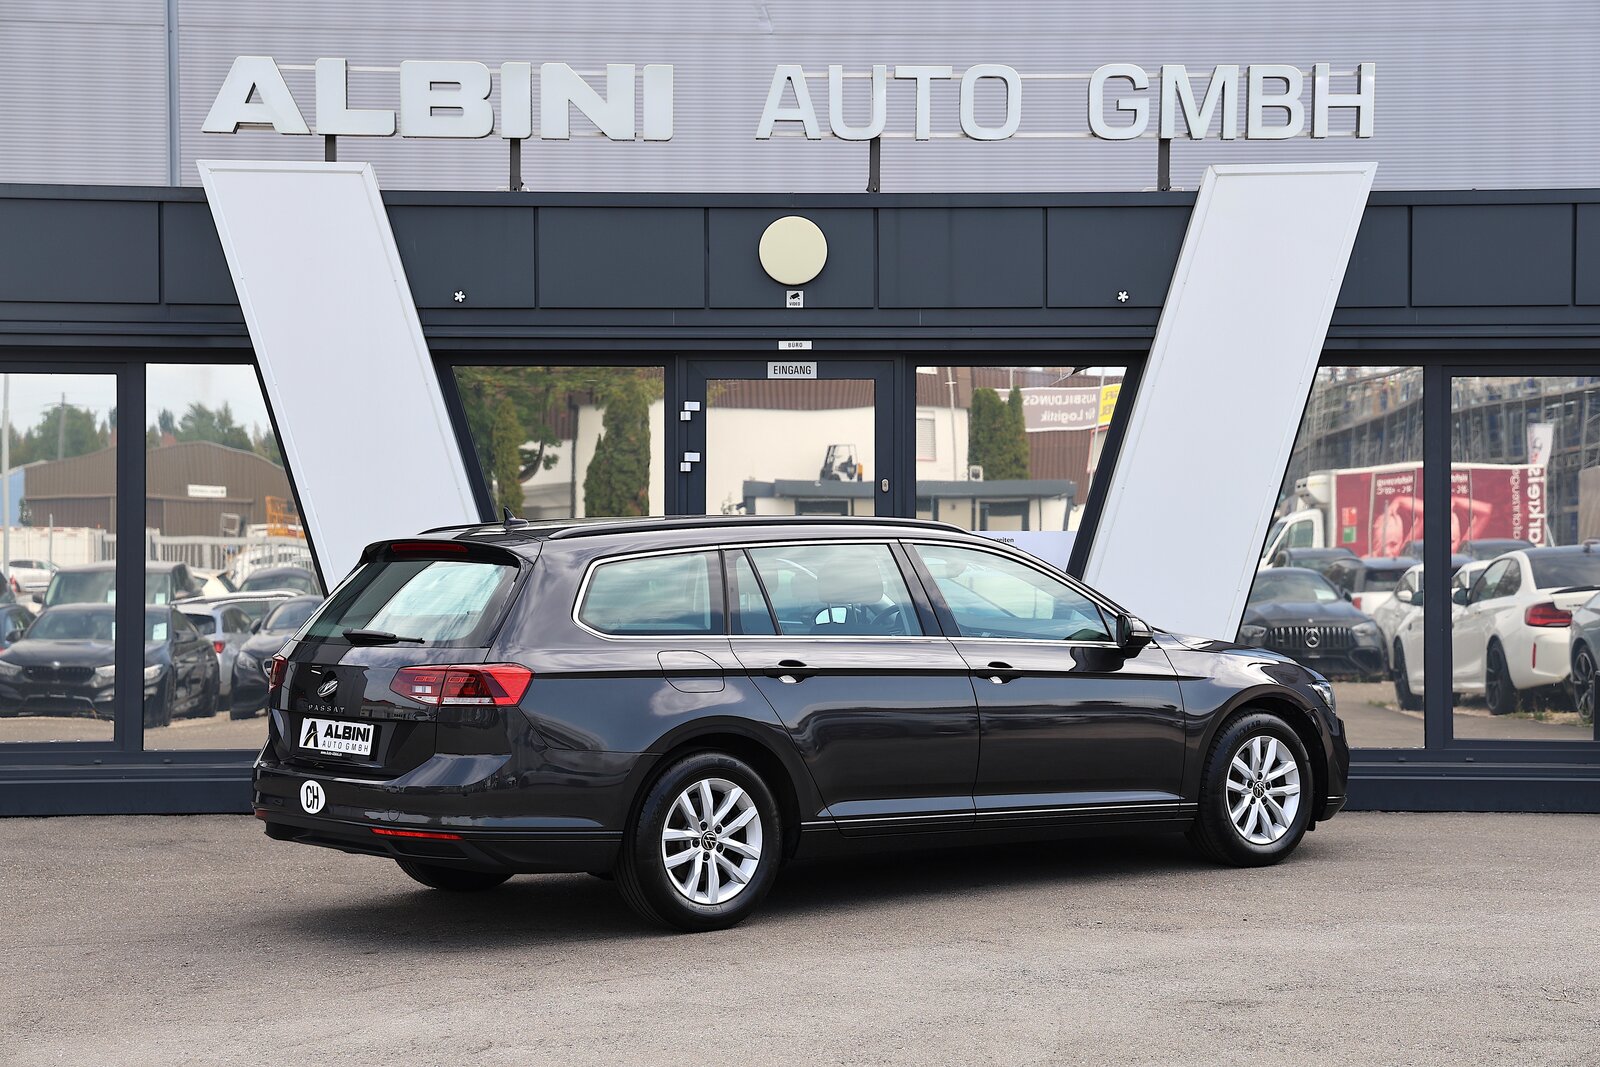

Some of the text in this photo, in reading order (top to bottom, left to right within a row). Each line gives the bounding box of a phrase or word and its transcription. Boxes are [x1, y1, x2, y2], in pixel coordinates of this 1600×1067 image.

[201, 56, 1375, 142] ALBINI AUTO GMBH
[773, 365, 812, 375] EINGANG
[308, 704, 345, 713] PASSAT
[324, 723, 370, 742] ALBINI
[321, 740, 368, 752] AUTO GMBH
[305, 785, 319, 810] CH
